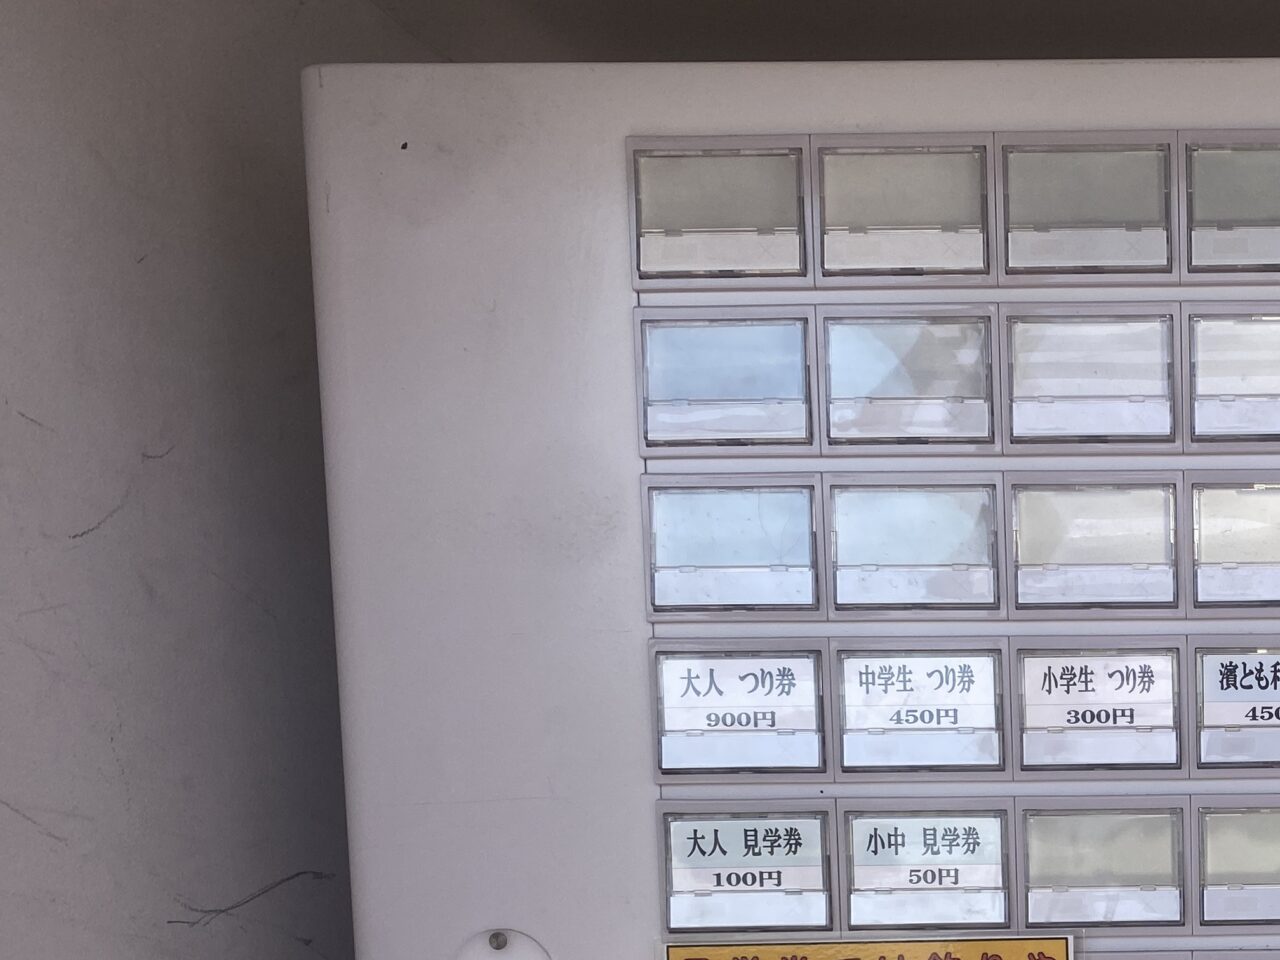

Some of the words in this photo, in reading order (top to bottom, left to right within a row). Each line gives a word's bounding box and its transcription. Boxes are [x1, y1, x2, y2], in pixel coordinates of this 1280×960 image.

[680, 667, 725, 699] 大人
[738, 666, 797, 699] つり券
[858, 664, 914, 695] 中学生
[926, 664, 976, 695] つり券
[1041, 664, 1097, 695] 小学生
[1107, 663, 1155, 695] つり券
[706, 709, 776, 730] 900円
[888, 706, 959, 727] 450円
[1066, 706, 1136, 726] 300円
[686, 828, 729, 859] 大人
[742, 826, 804, 857] 見学券
[866, 827, 907, 857] 小中
[922, 825, 982, 856] 見学券
[712, 869, 782, 889] 100円
[907, 867, 960, 887] 50円
